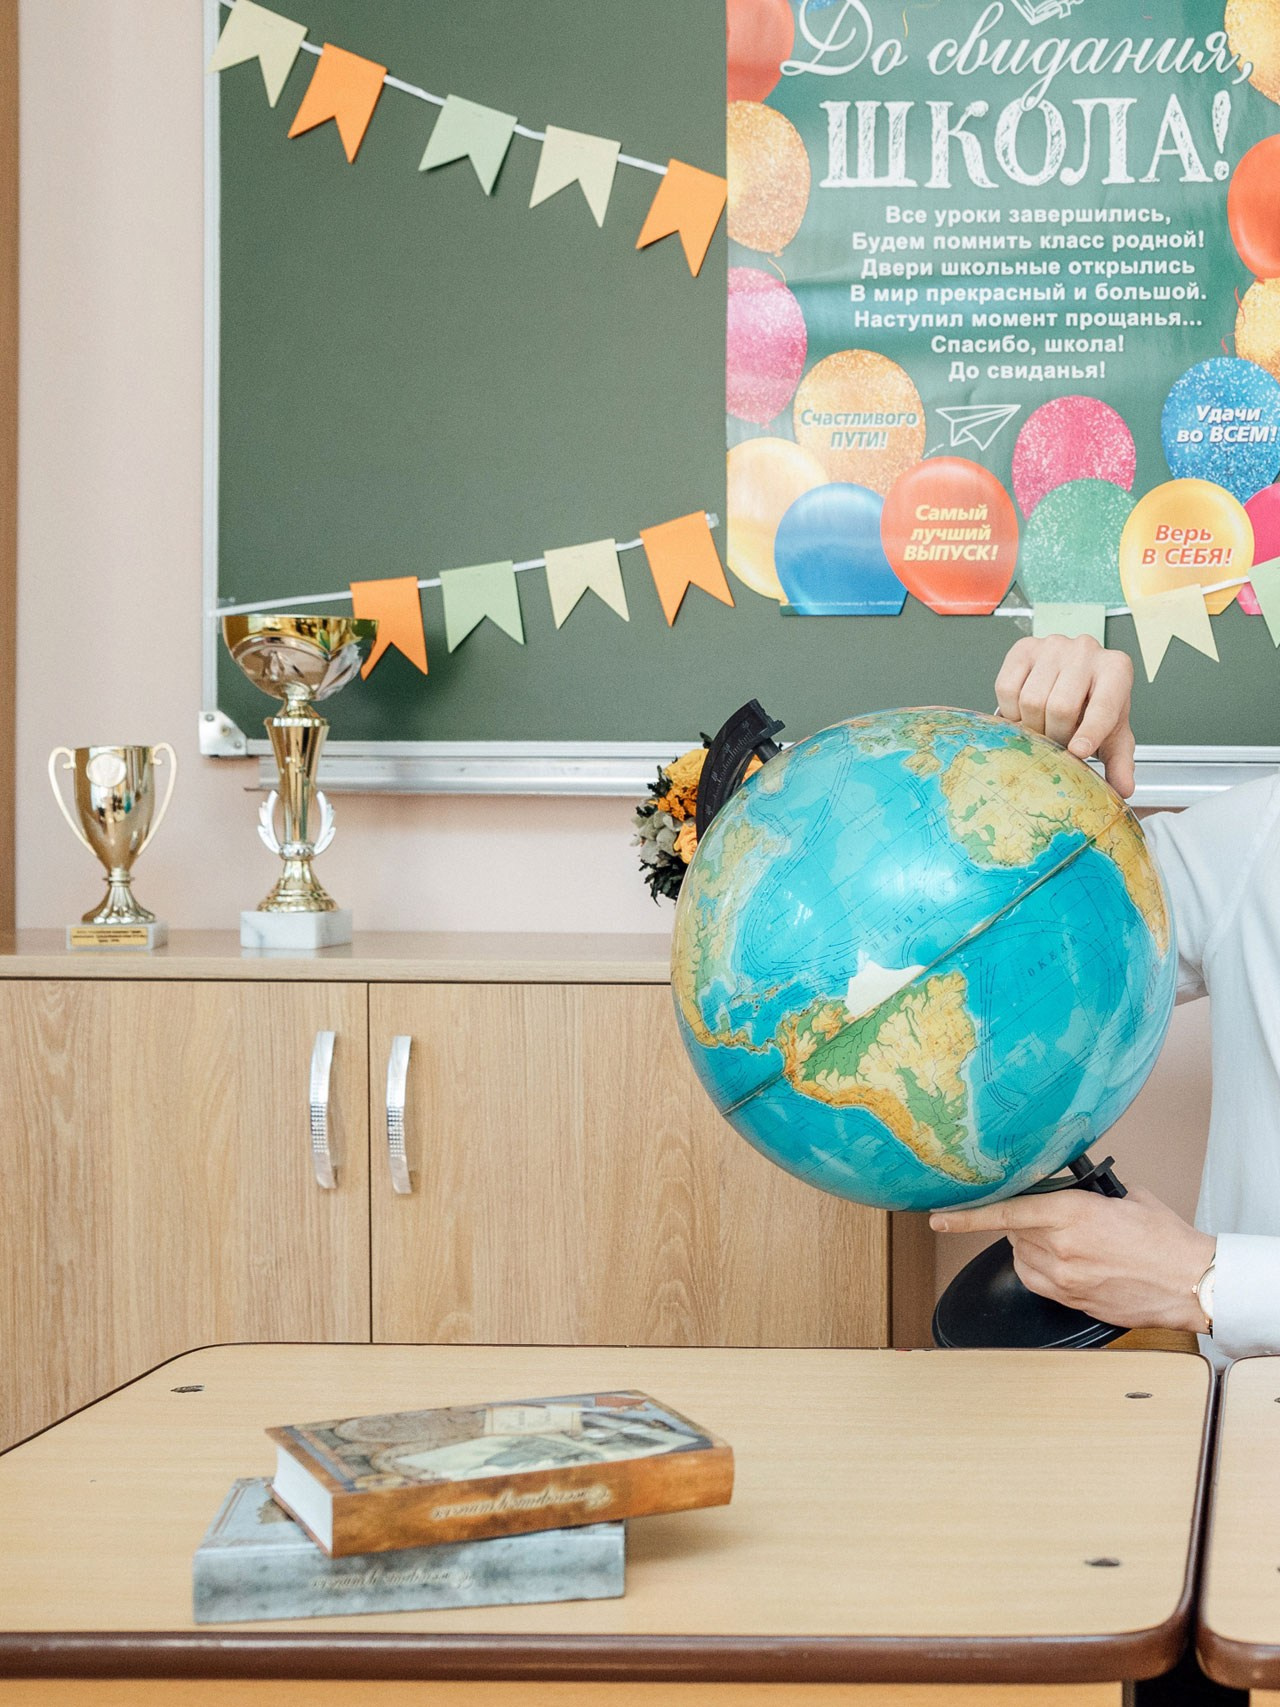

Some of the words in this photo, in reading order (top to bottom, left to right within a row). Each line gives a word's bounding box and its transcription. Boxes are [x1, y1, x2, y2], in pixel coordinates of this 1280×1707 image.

[779, 0, 909, 77] До
[927, 1, 1254, 108] свидания,
[818, 90, 1232, 189] ШКОЛА!
[885, 205, 927, 224] Все
[934, 209, 1001, 228] уроки
[1008, 208, 1172, 227] завершились,
[852, 232, 925, 255] Будем
[933, 235, 1032, 250] помнить
[1039, 235, 1105, 249] класс
[1111, 231, 1204, 252] родной!
[860, 258, 933, 279] Двери
[941, 261, 1061, 276] школьные
[1067, 260, 1195, 279] открылись
[850, 284, 866, 302] В
[874, 288, 919, 306] мир
[926, 283, 1066, 306] прекрасный
[1074, 287, 1087, 300] и
[1094, 282, 1206, 301] большой.
[854, 310, 963, 331] Наступил
[971, 313, 1058, 328] момент
[1065, 312, 1202, 330] прощанья...
[931, 335, 1036, 356] Спасибо,
[1044, 335, 1124, 353] школа!
[948, 361, 980, 383] До
[987, 361, 1105, 382] свиданья!
[800, 408, 919, 428] Счастливого
[1196, 405, 1261, 424] Удачи
[830, 430, 889, 449] ПУТИ!
[1176, 429, 1203, 443] во
[1209, 426, 1278, 443] ВСЕМ!
[915, 504, 988, 522] Самый
[910, 525, 992, 545] лучший
[1154, 524, 1212, 545] Верь
[903, 545, 999, 562] ВЫПУСК!
[1141, 548, 1157, 565] В
[1164, 548, 1233, 566] СЕБЯ!
